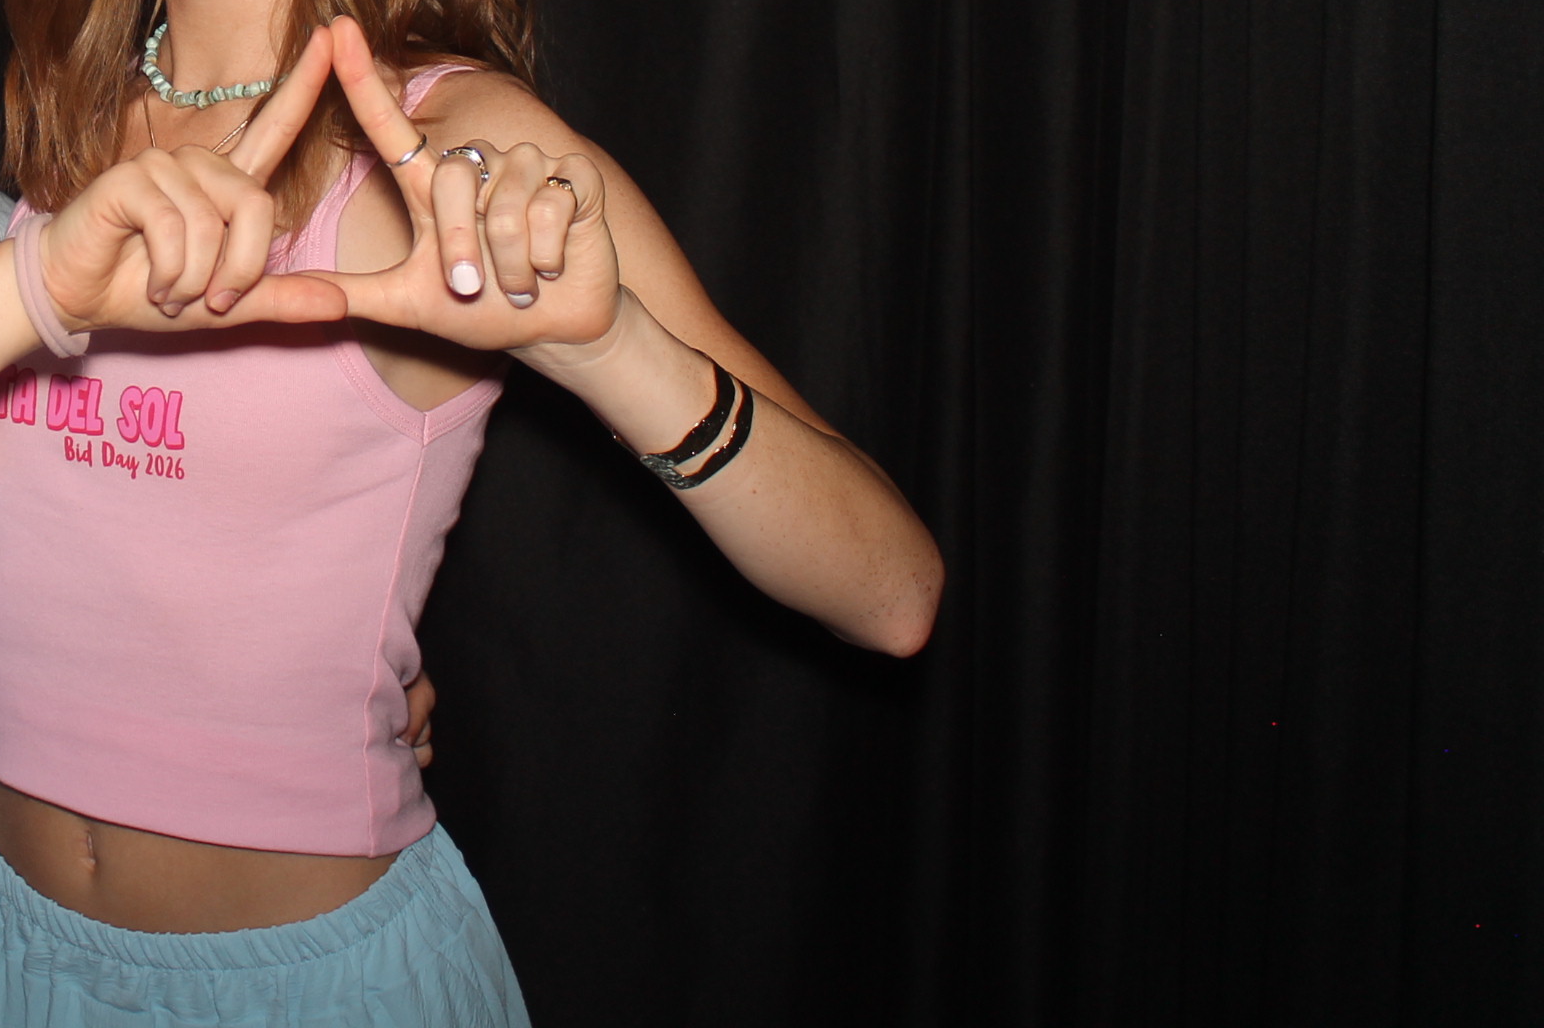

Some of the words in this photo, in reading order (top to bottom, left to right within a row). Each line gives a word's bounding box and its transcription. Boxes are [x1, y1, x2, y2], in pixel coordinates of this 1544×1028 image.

[46, 374, 104, 436] DEL
[116, 385, 185, 450] SOL
[63, 436, 92, 467] Bid
[101, 441, 139, 479] Day
[144, 452, 185, 480] 2026
